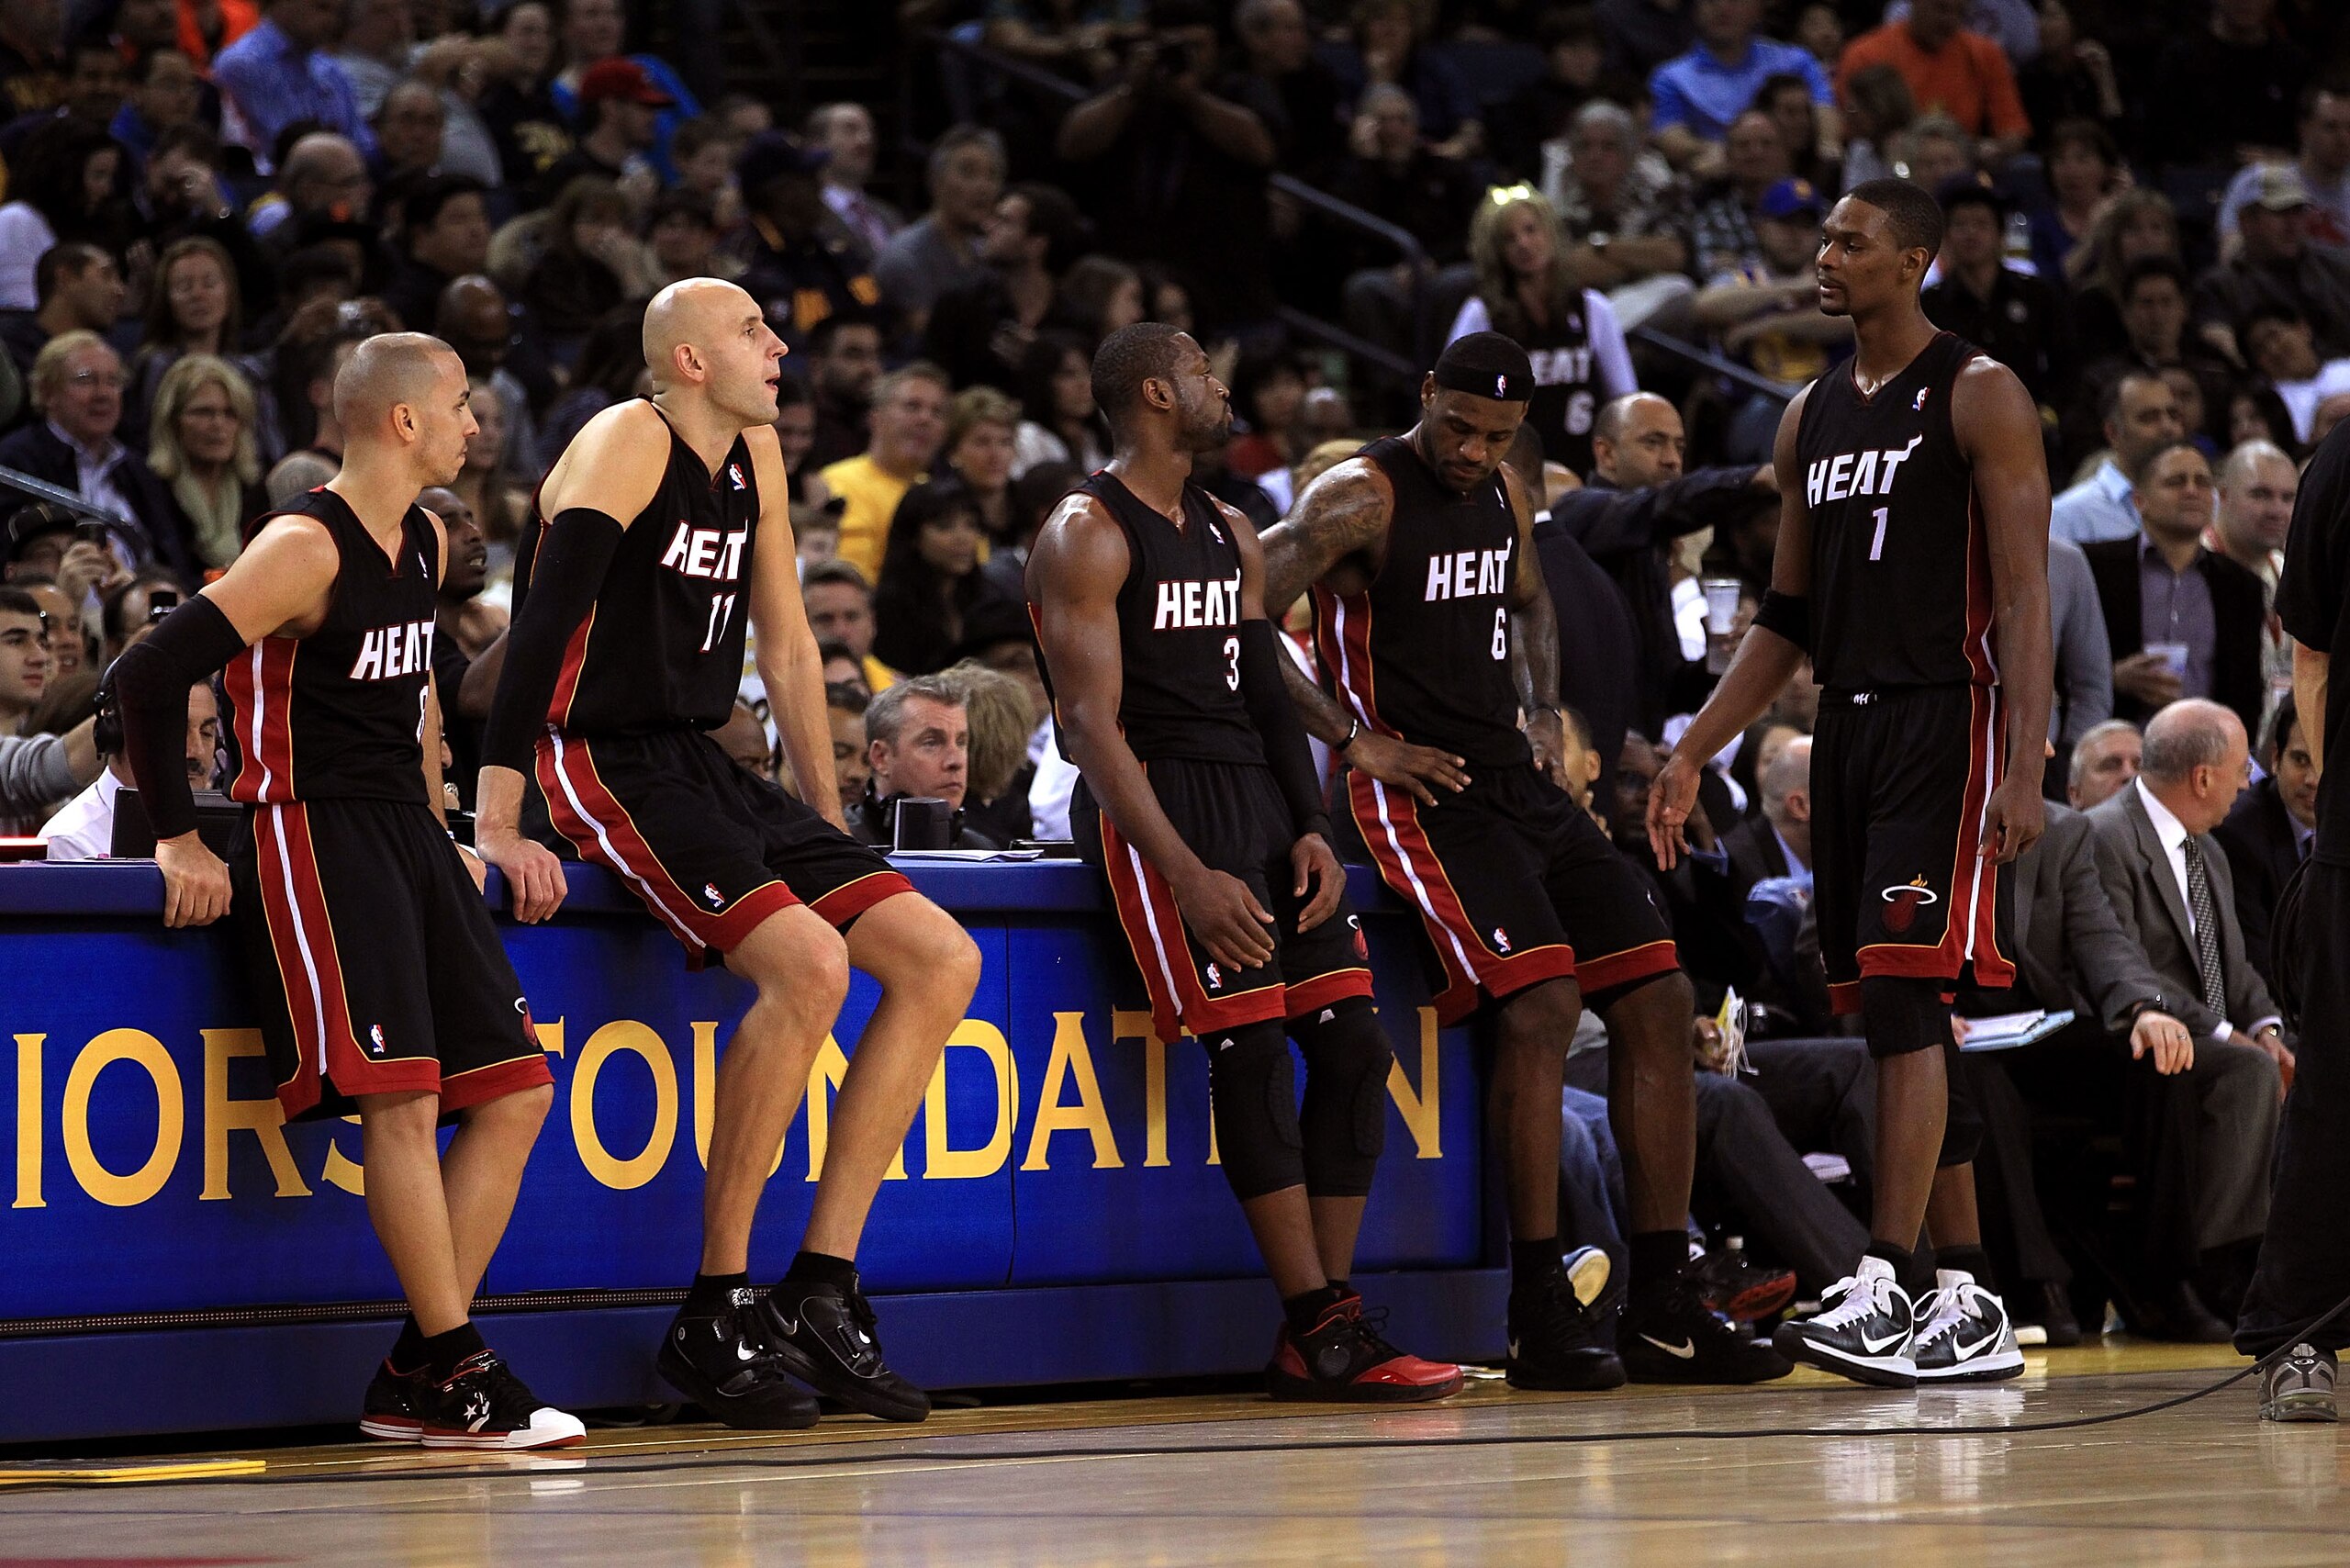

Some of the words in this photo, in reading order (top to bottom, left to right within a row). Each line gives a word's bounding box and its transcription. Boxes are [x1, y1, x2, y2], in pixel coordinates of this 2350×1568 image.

[1563, 388, 1596, 438] 6
[1807, 432, 1923, 510] HEAT
[1868, 506, 1889, 561] 1
[1152, 566, 1241, 631] HEAT
[1424, 535, 1513, 602] HEAT
[347, 608, 437, 681] HEAT
[699, 592, 737, 653] 11
[1490, 606, 1507, 661] 6
[1223, 635, 1240, 691] 3
